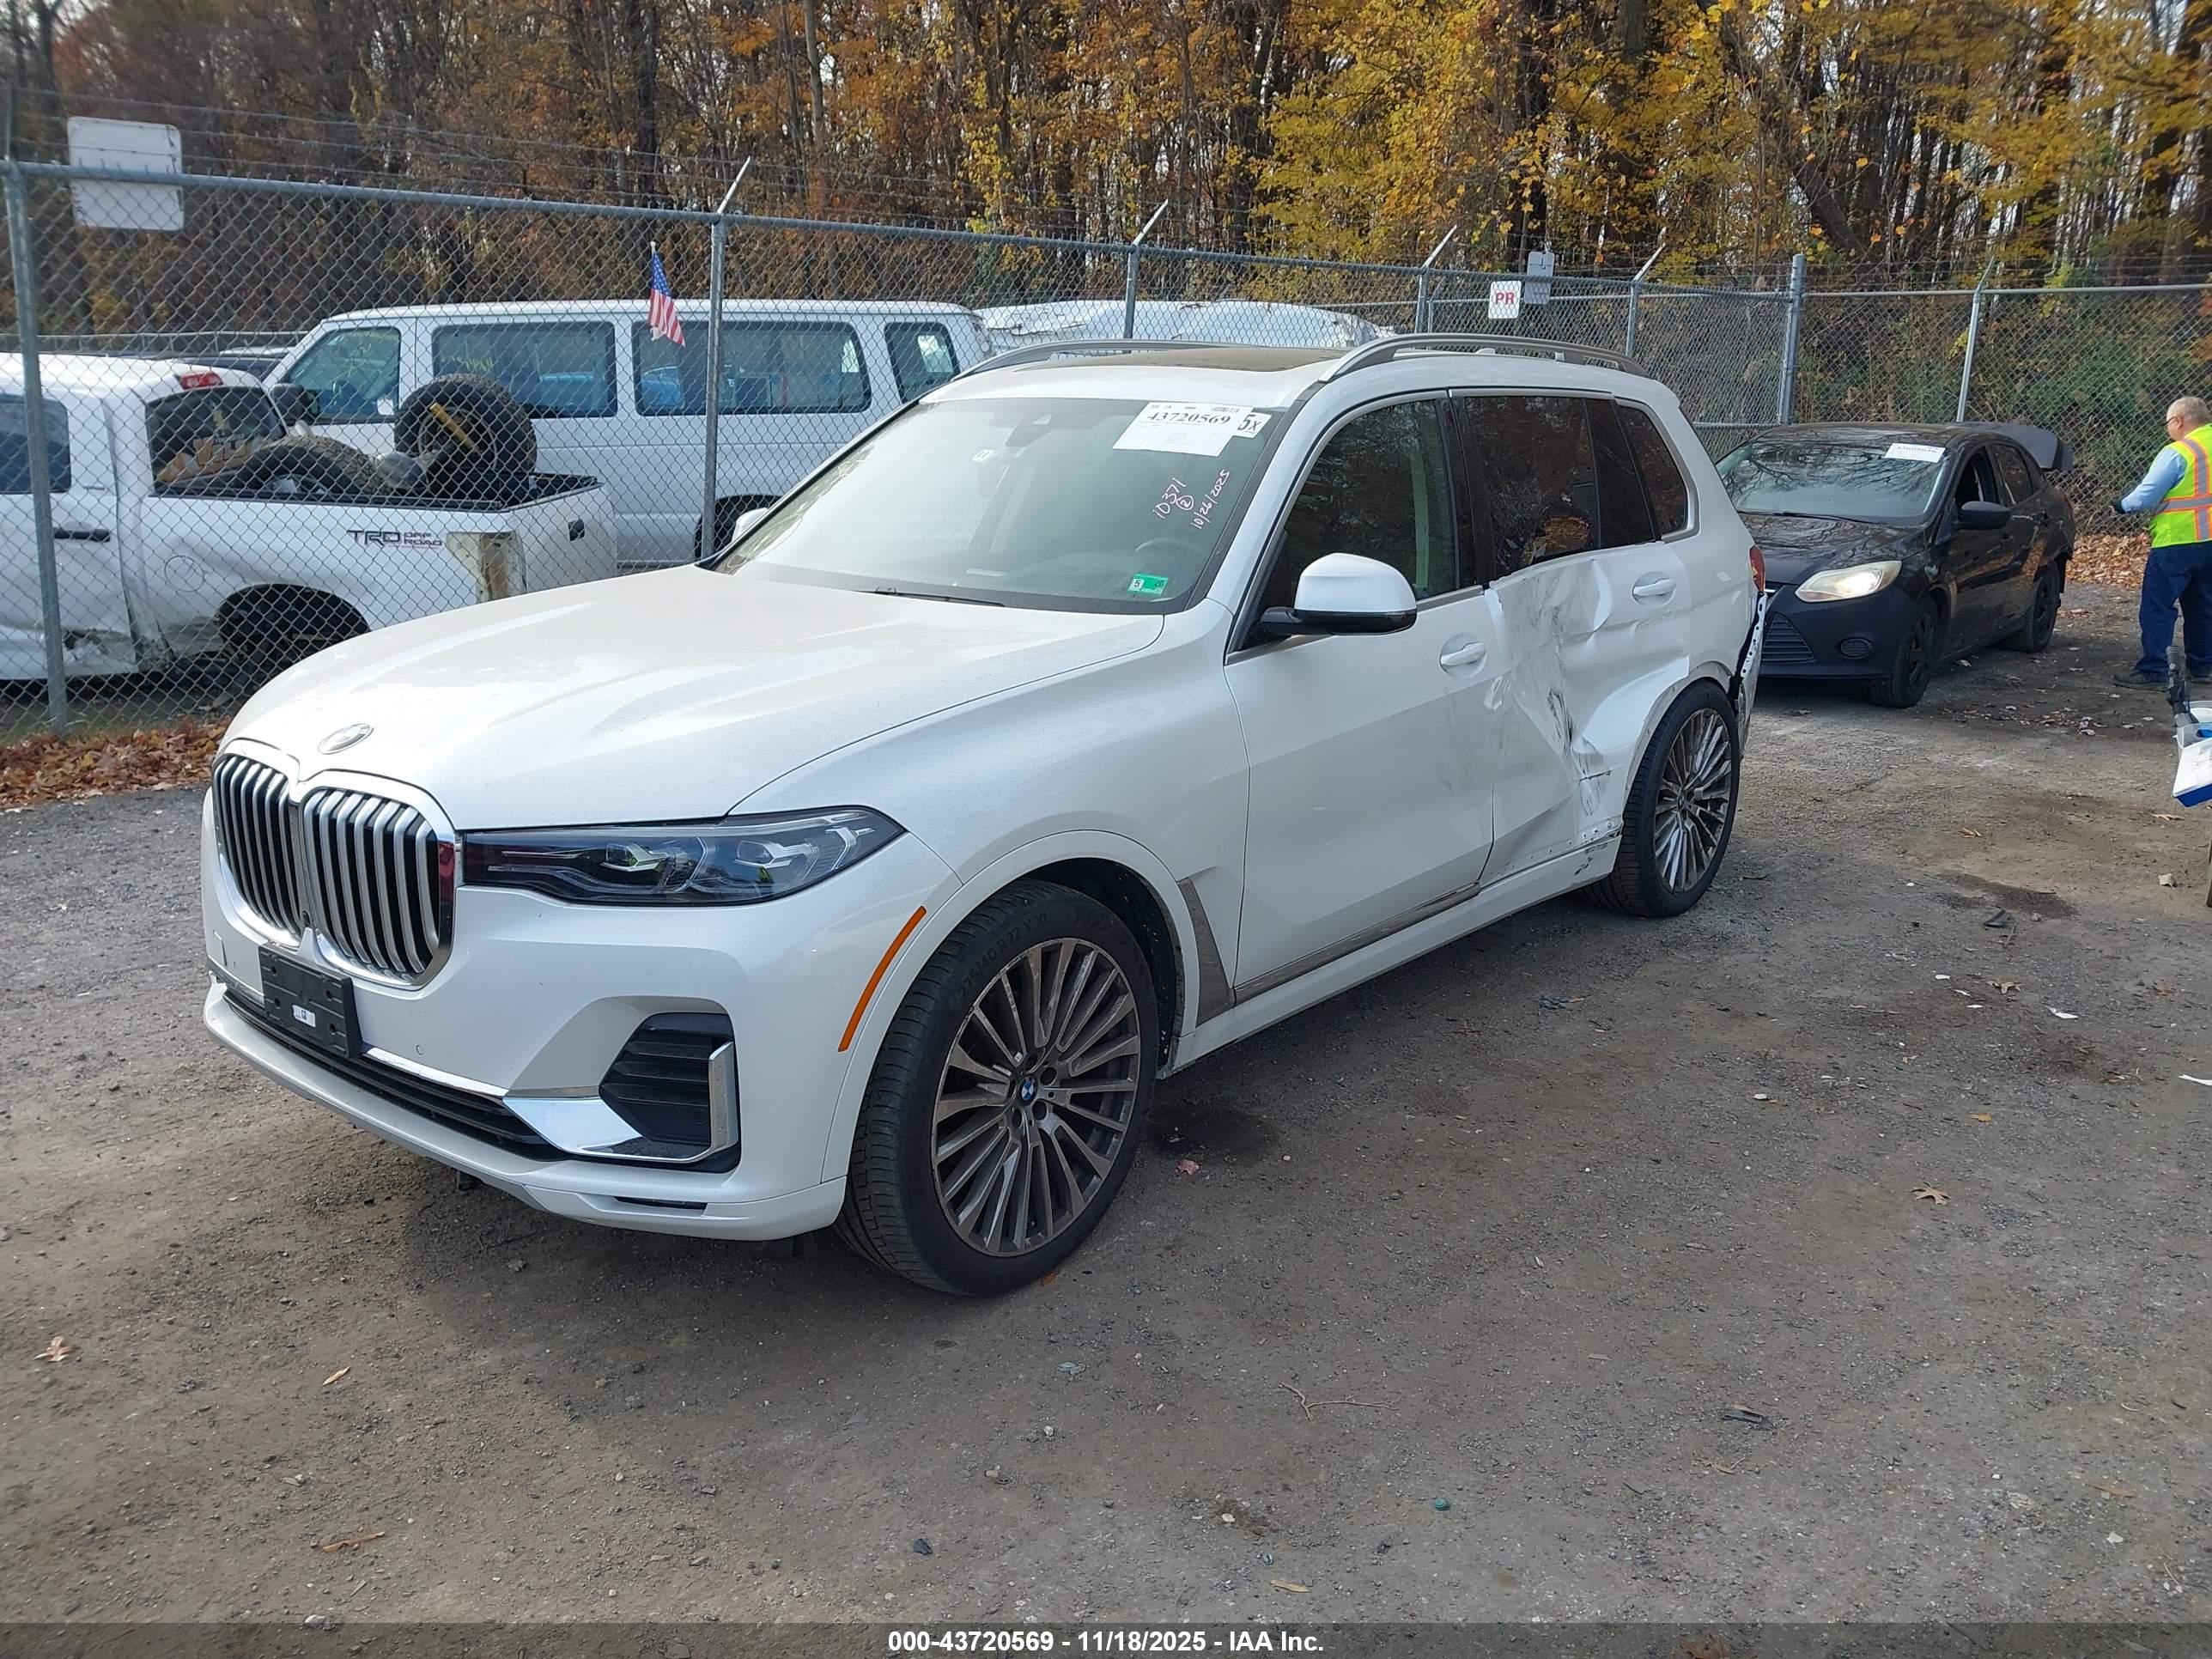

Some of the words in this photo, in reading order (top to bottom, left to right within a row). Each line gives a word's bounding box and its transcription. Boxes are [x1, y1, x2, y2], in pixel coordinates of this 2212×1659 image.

[1495, 292, 1515, 305] PR
[1147, 411, 1231, 425] 43720569
[1190, 469, 1230, 529] 10/26/2025
[346, 530, 400, 546] TRD
